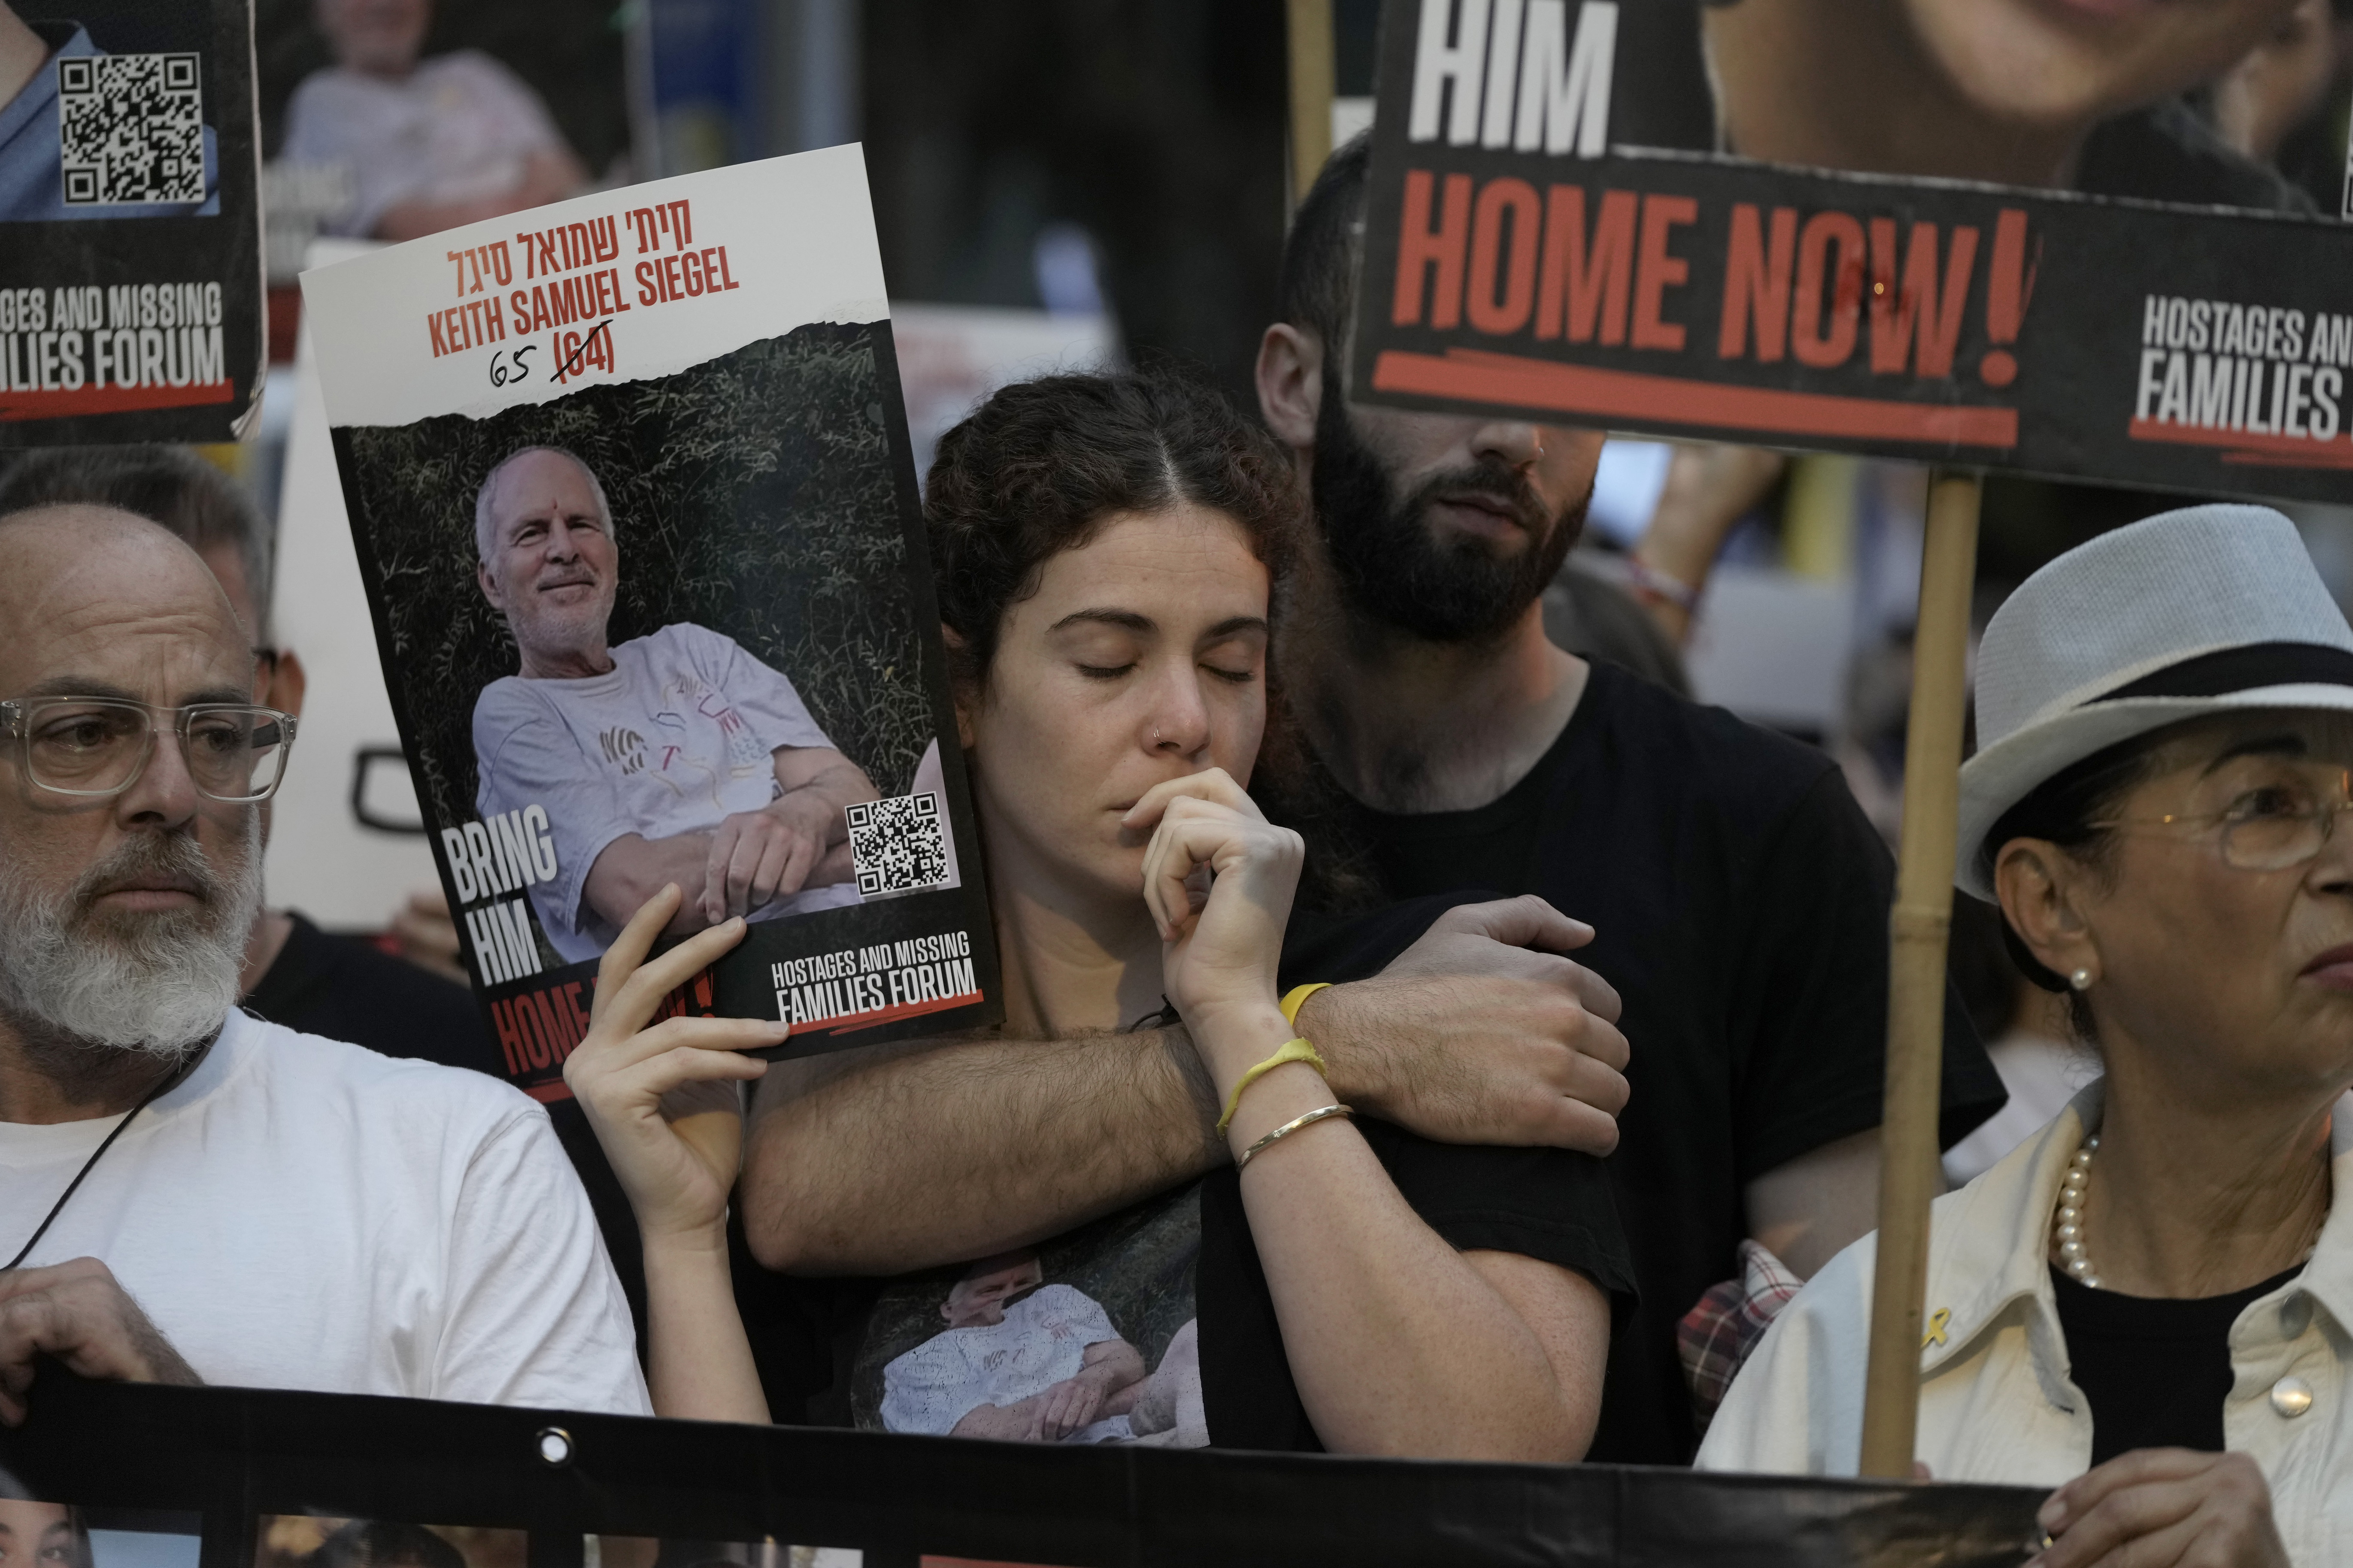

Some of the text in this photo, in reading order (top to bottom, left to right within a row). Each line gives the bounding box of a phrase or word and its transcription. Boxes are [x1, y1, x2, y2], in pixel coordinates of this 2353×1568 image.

[1409, 0, 1619, 159] HIM
[447, 199, 693, 298] קית' שמואל סיגל
[1392, 170, 2035, 386] HOME NOW!
[0, 281, 222, 333] GES AND MISSING
[428, 245, 740, 358] KEITH SAMUEL SIEGEL
[2143, 294, 2353, 367] HOSTAGES AN
[93, 325, 225, 390] FORUM
[491, 346, 537, 387] 65
[2135, 347, 2343, 442] FAMILIES
[441, 803, 558, 904] BRING
[465, 897, 543, 987] HIM
[771, 930, 970, 988] HOSTAGES AND MISSING
[776, 973, 885, 1025] FAMILIES
[888, 957, 977, 1008] FORUM
